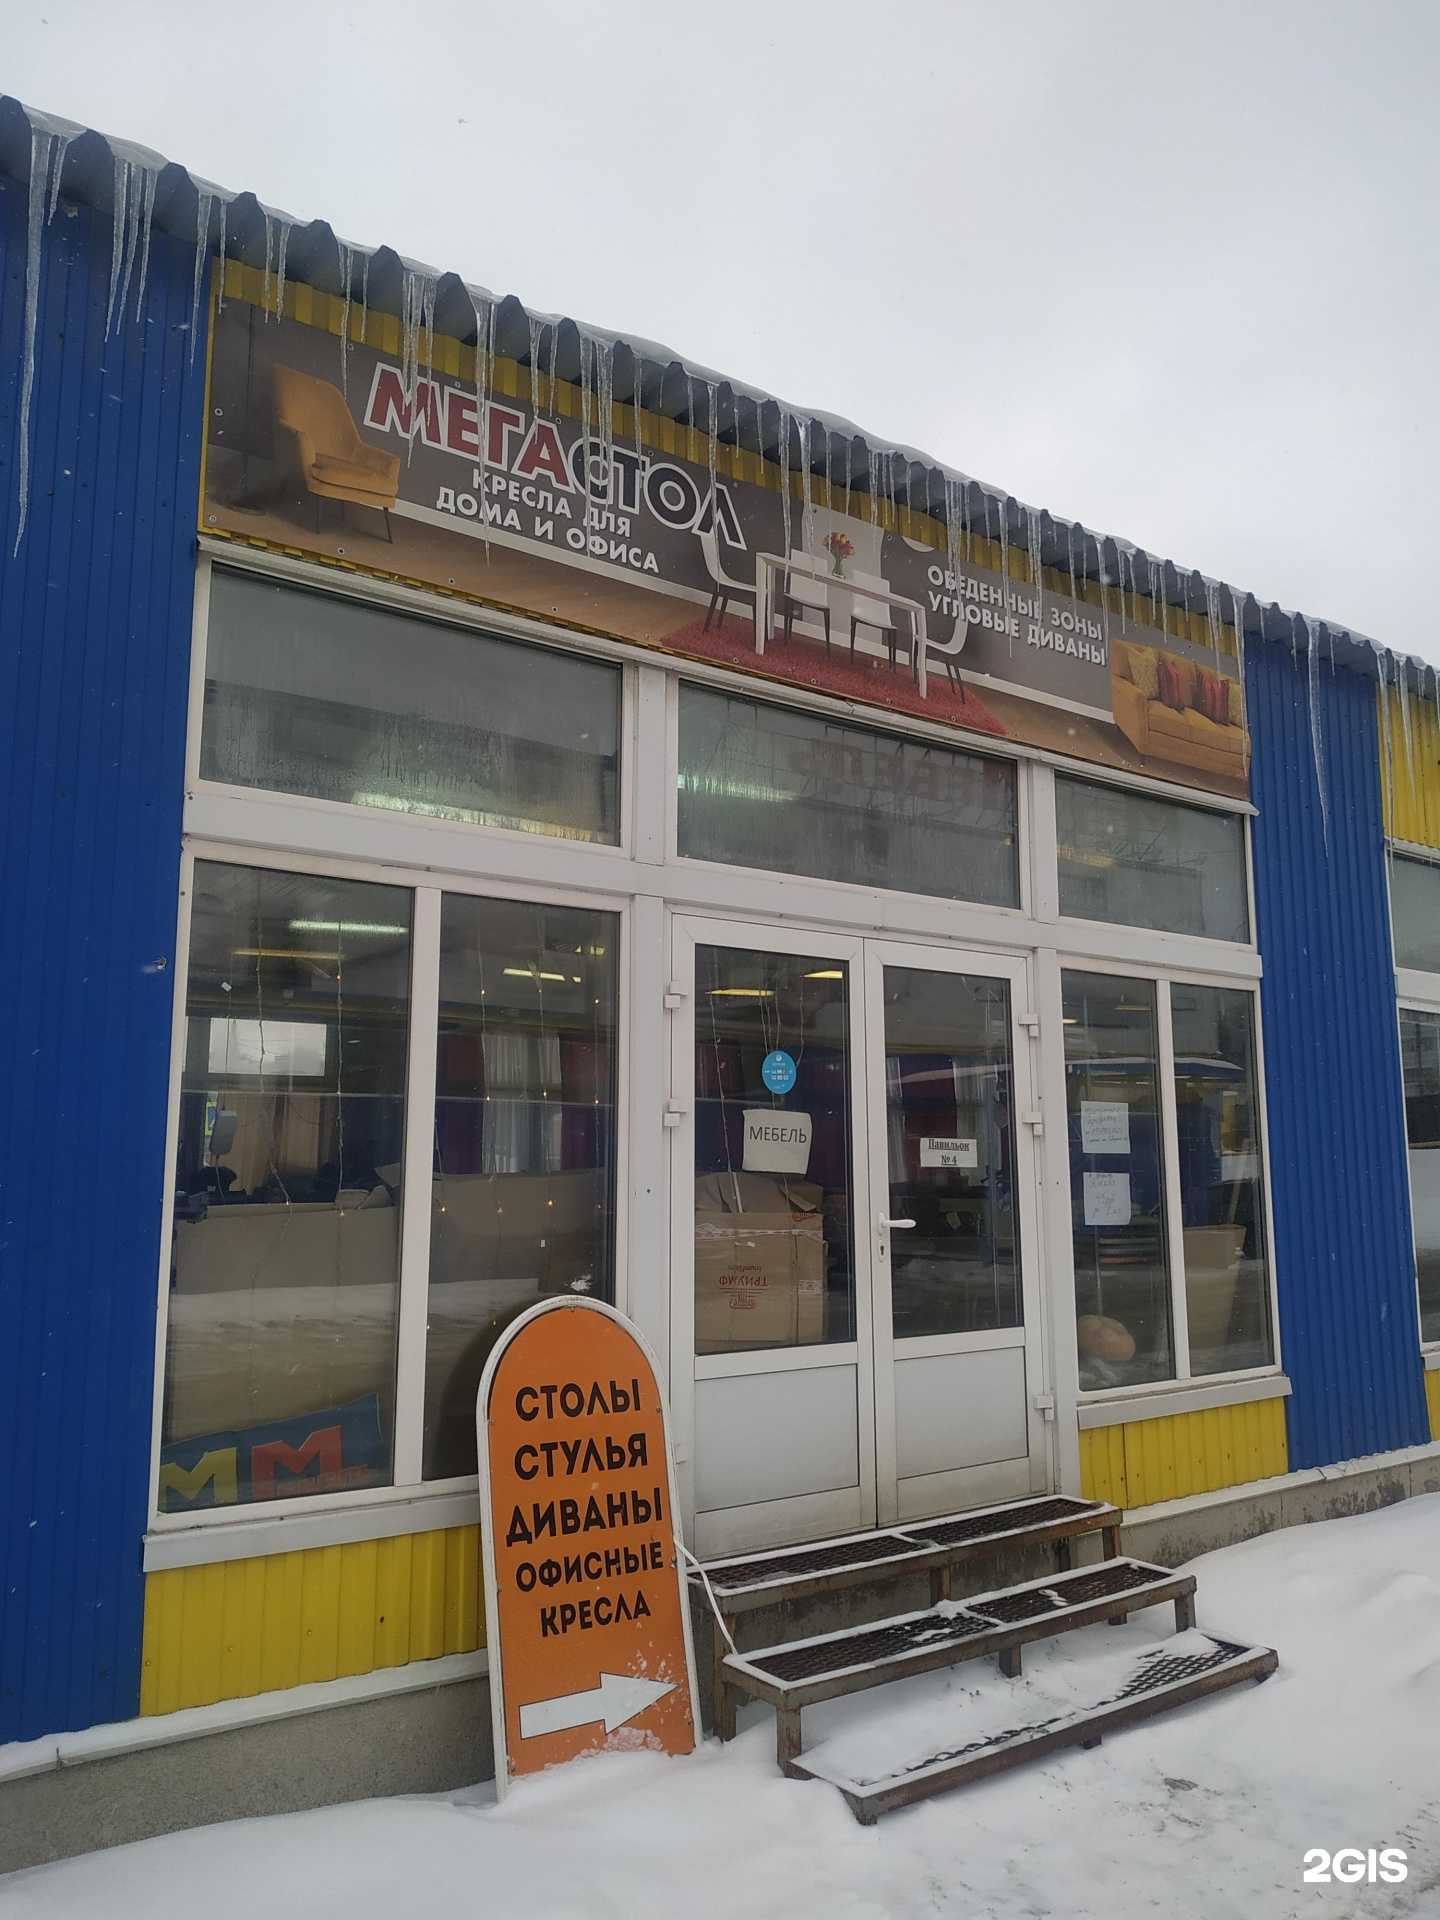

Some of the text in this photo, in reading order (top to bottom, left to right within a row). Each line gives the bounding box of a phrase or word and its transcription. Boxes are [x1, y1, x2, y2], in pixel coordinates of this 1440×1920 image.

[363, 362, 748, 550] МЕГАСТОЛ
[436, 486, 659, 573] ДОМА И ОФИСА
[472, 469, 631, 537] КРЕСЛА ДЛЯ
[927, 565, 1103, 641] ОБЕДЕННЫЕ ЗОНЫ
[927, 591, 1106, 666] УГЛОВЫЕ ДИВАНЫ
[750, 1126, 807, 1144] МЕБЕЛЬ
[515, 1378, 640, 1421] СТОЛЫ
[514, 1432, 648, 1480] СТУЛЬЯ
[505, 1487, 663, 1547] ДИВАНЫ
[516, 1541, 663, 1593] ОФИСНЫЕ
[540, 1590, 651, 1637] КРЕСЛА
